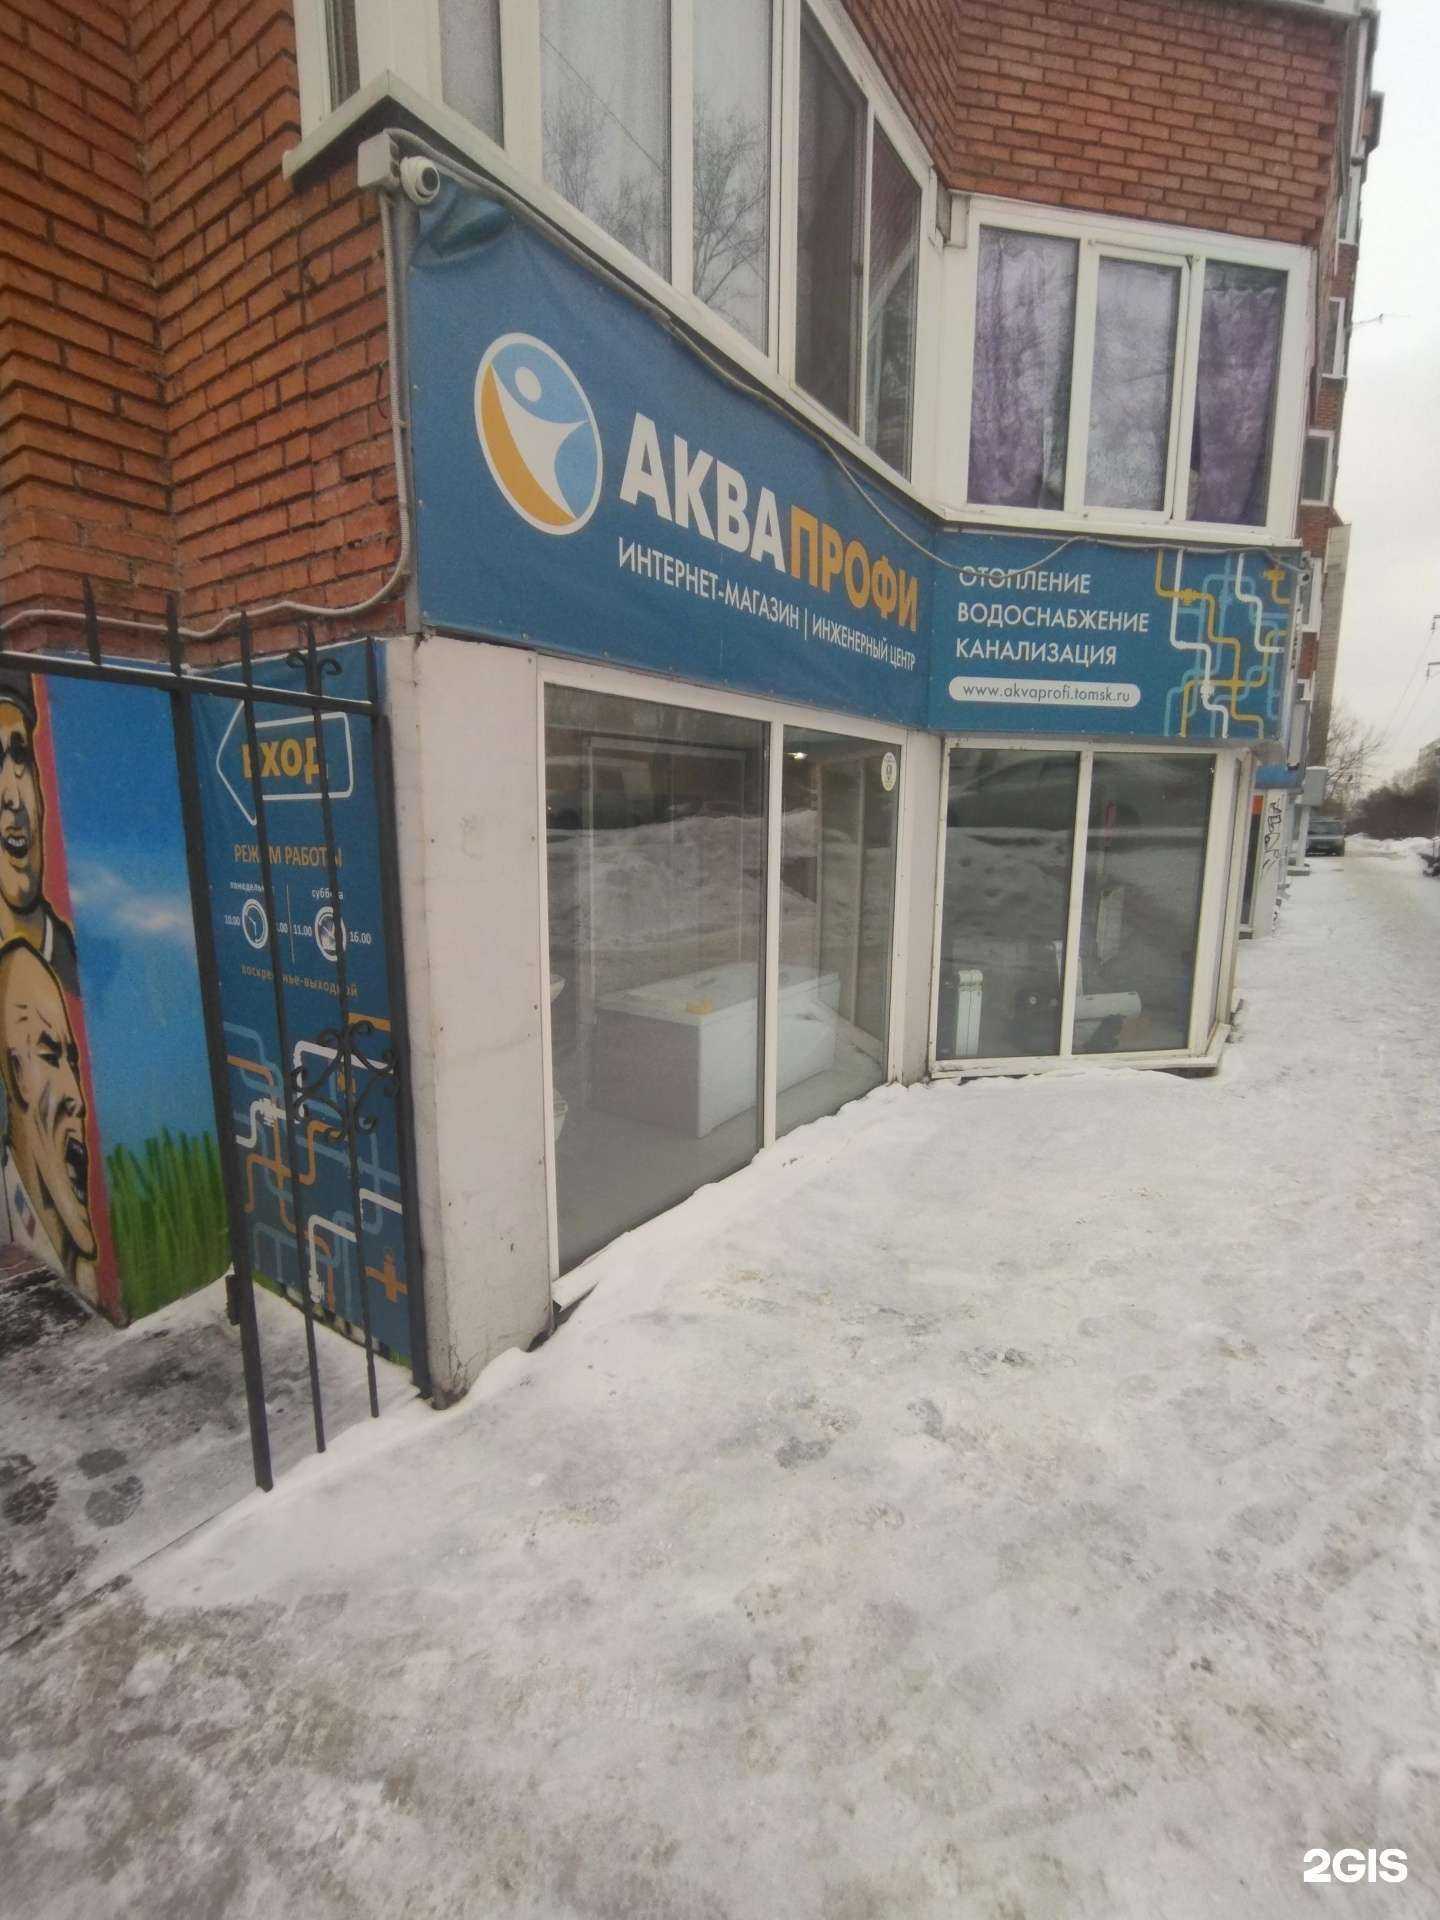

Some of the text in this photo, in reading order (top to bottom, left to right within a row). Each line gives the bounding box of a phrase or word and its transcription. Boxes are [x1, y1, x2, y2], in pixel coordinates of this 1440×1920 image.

[958, 566, 1091, 594] ОТОПЛЕНИЕ
[618, 536, 916, 671] ИНТЕРНЕТ-МАГАЗИН ИНЖЕНЕРНЫЙ ЦЕНТР
[957, 602, 1150, 633] ВОДОСНАБЖЕНИЕ
[956, 638, 1117, 668] КАНАЛИЗАЦИЯ
[962, 682, 1131, 703] www.akvaprofi.tomsk.ru
[234, 844, 281, 864] РЕЖМ
[311, 888, 344, 900] субба
[293, 925, 312, 937] 11.00
[350, 931, 372, 945] 16.00
